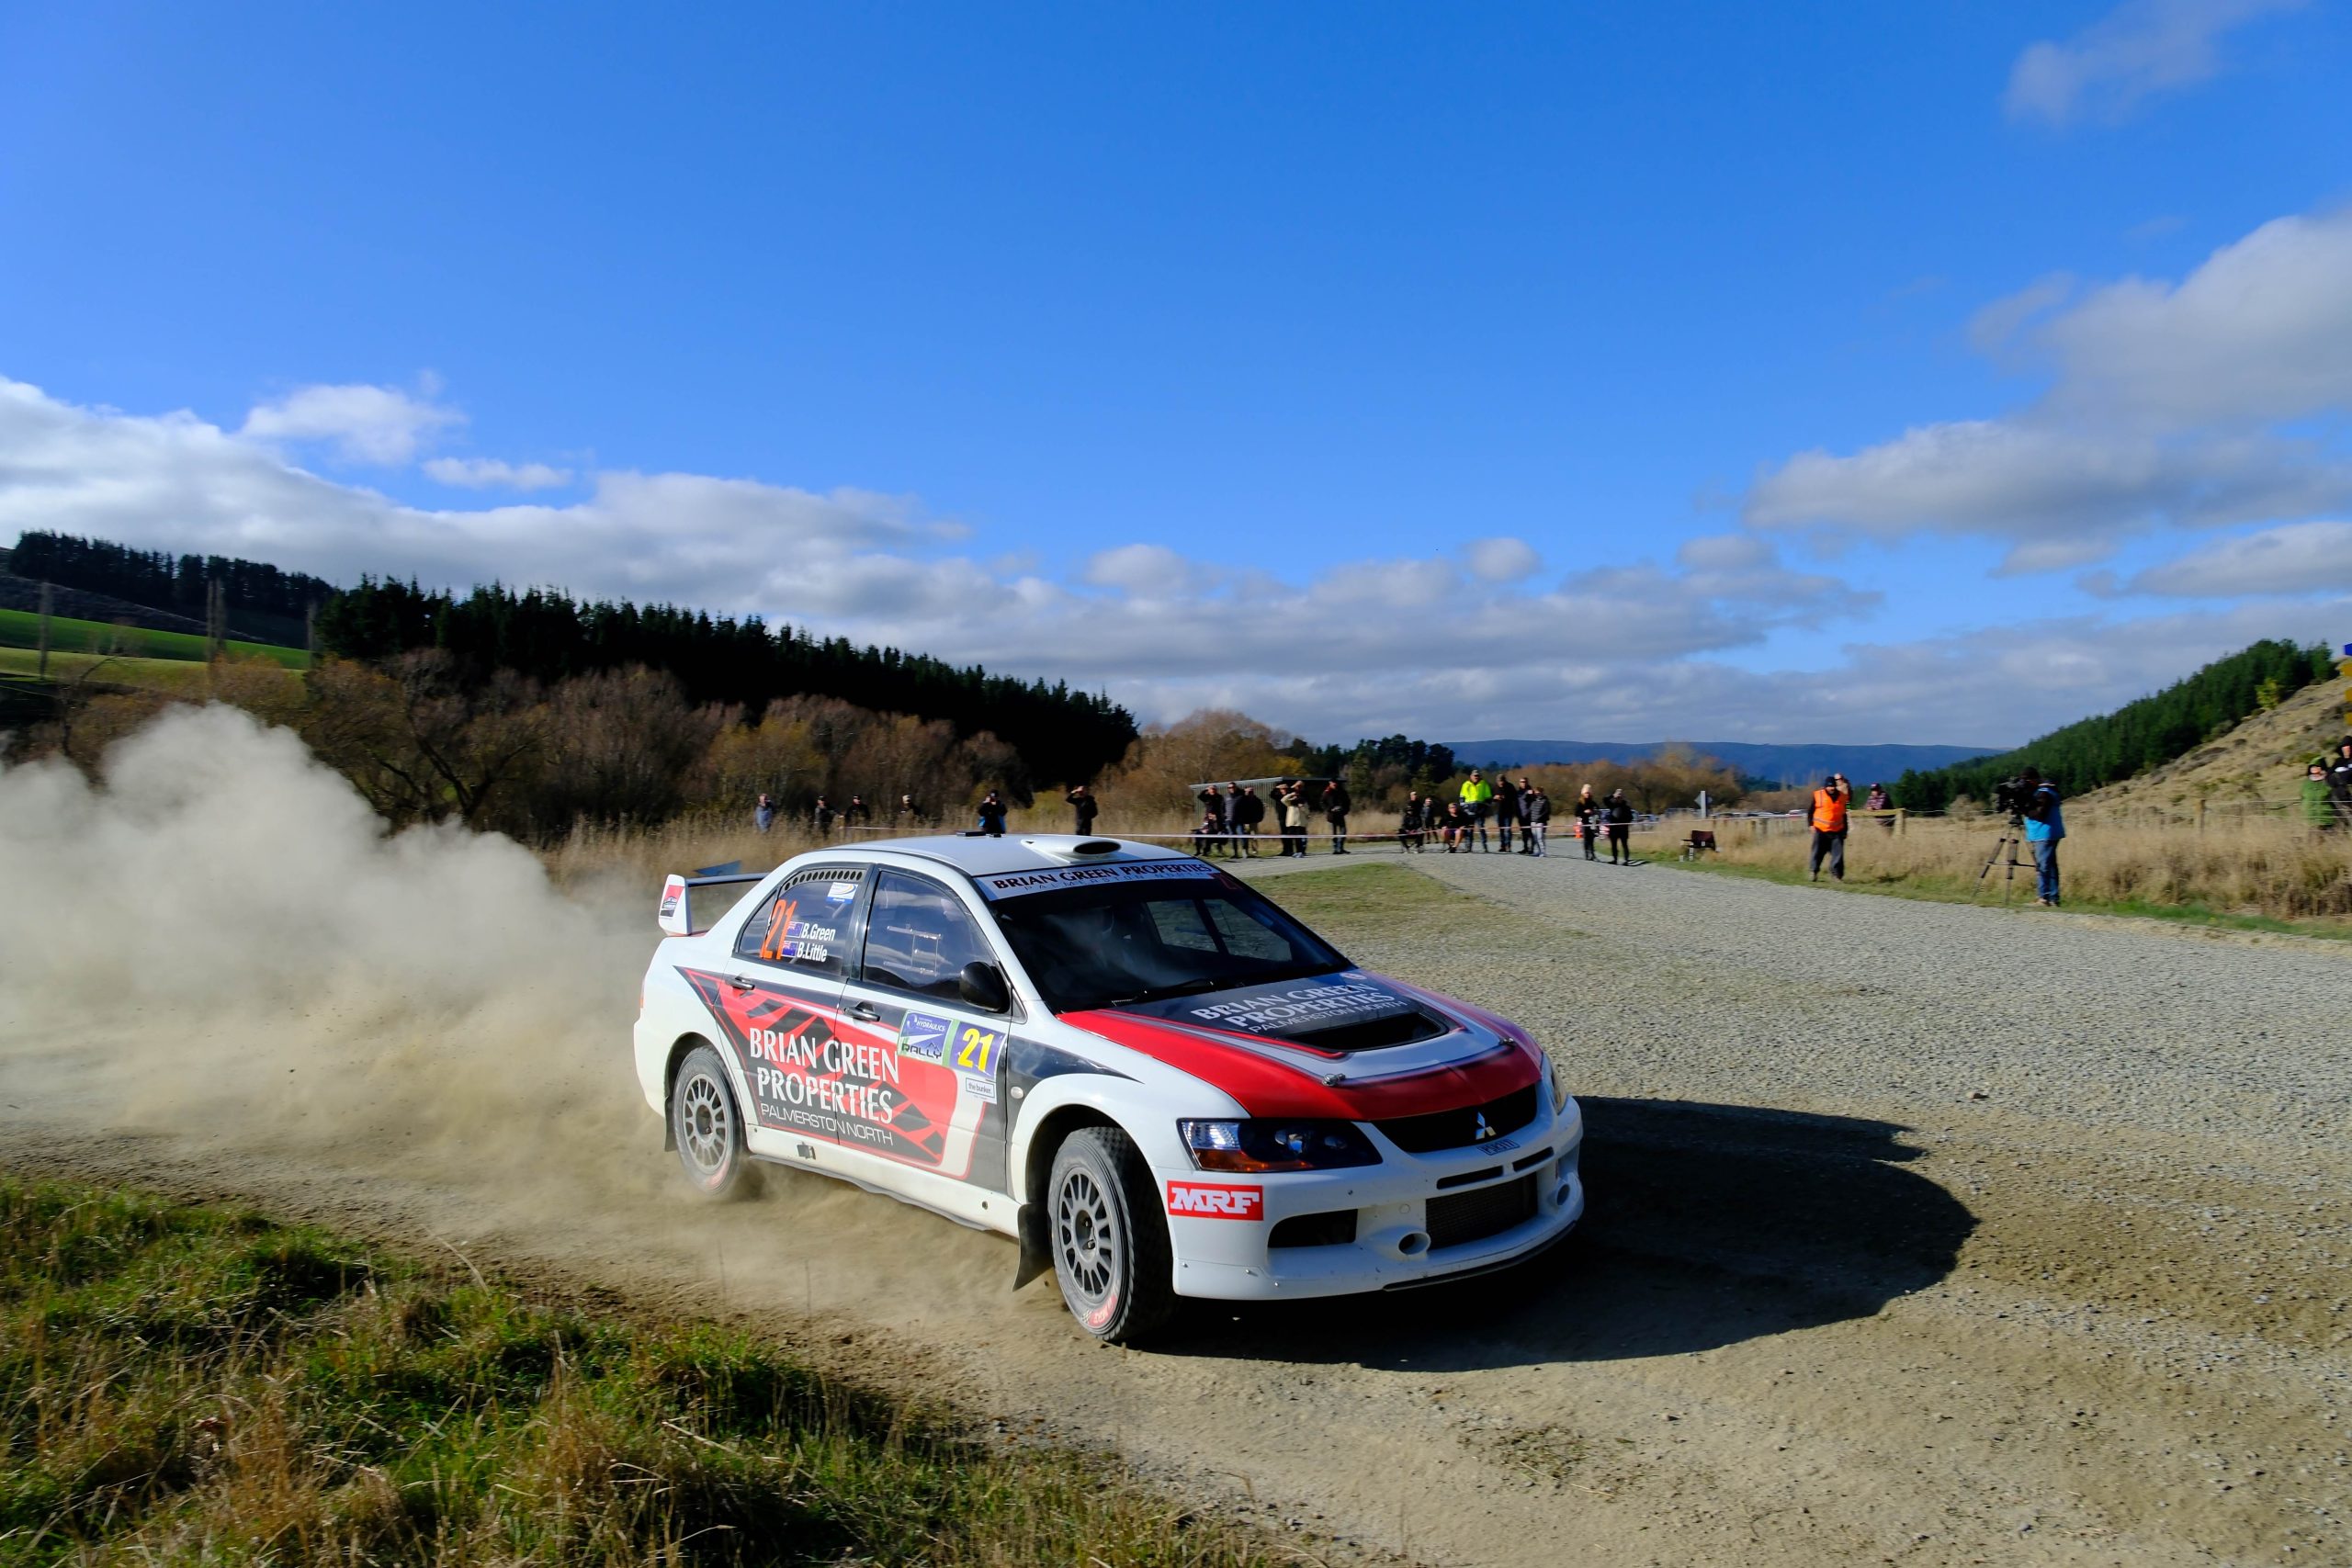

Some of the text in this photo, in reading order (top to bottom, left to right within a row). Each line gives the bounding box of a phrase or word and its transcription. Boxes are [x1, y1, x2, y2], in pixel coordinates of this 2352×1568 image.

[993, 863, 1212, 889] BRIAN GREEN PROPERTIES
[760, 899, 797, 961] 21
[801, 922, 836, 942] B.Green
[797, 942, 828, 962] B.Little
[1191, 983, 1379, 1020] BRIAN GREEN
[1224, 991, 1395, 1027] PROPERTIES
[1248, 1007, 1353, 1033] PALMERSTON
[749, 1027, 899, 1084] BRIAN GREEN
[901, 1043, 943, 1058] RALLY
[957, 1028, 995, 1073] 21
[757, 1066, 893, 1124] PROPERTIES
[761, 1103, 894, 1145] PALMERSTON NORTH
[1170, 1187, 1260, 1214] MRF
